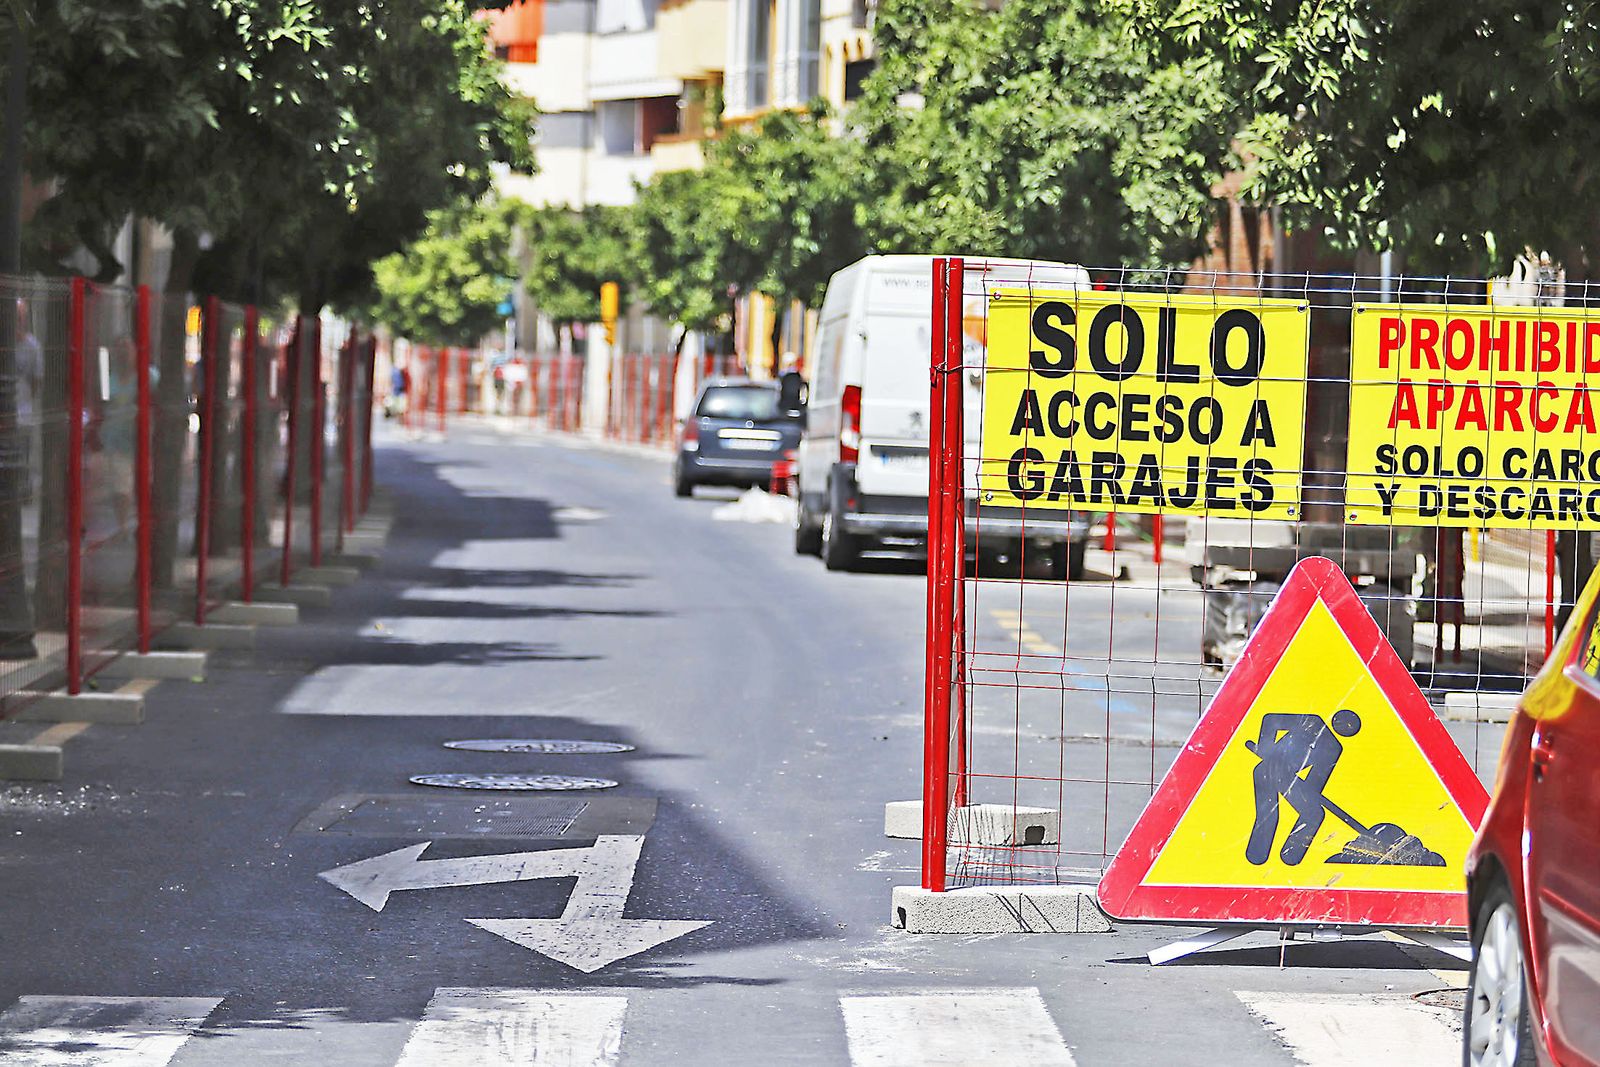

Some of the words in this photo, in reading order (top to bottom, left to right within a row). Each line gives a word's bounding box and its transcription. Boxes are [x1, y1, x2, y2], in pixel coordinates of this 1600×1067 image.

[1028, 301, 1266, 387] SOLO
[1010, 388, 1224, 446] ACCESO
[1240, 399, 1277, 448] A
[1388, 378, 1597, 434] APARCA
[1007, 447, 1275, 511] GARAJES
[1375, 443, 1484, 480] SOLO
[1373, 483, 1401, 517] Y
